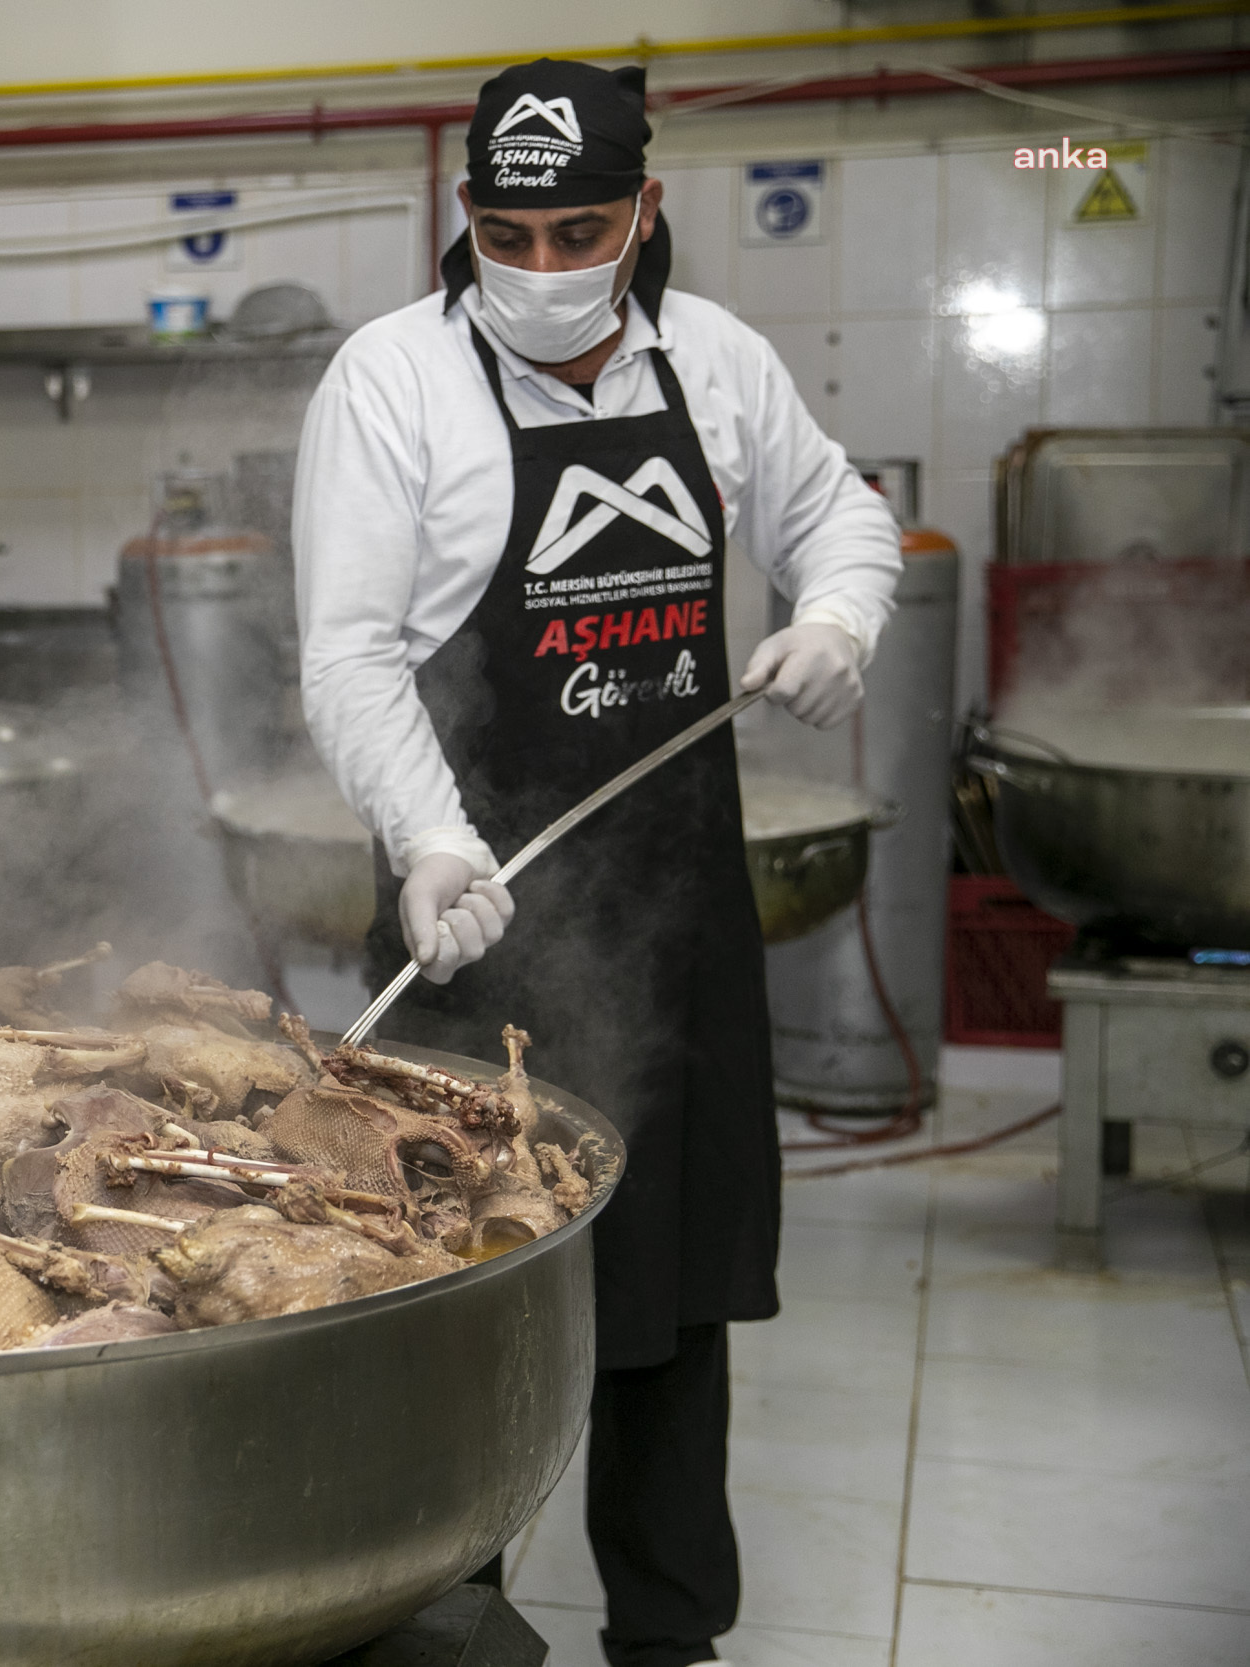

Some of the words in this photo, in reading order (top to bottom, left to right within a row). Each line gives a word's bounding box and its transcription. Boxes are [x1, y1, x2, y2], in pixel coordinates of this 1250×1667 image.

[490, 149, 571, 167] AŞHANE
[494, 167, 558, 189] Görevli
[524, 581, 548, 596] T.C.
[550, 575, 595, 593] MERSİN
[524, 594, 568, 610] SOSYAL
[534, 600, 708, 662] AŞHANE
